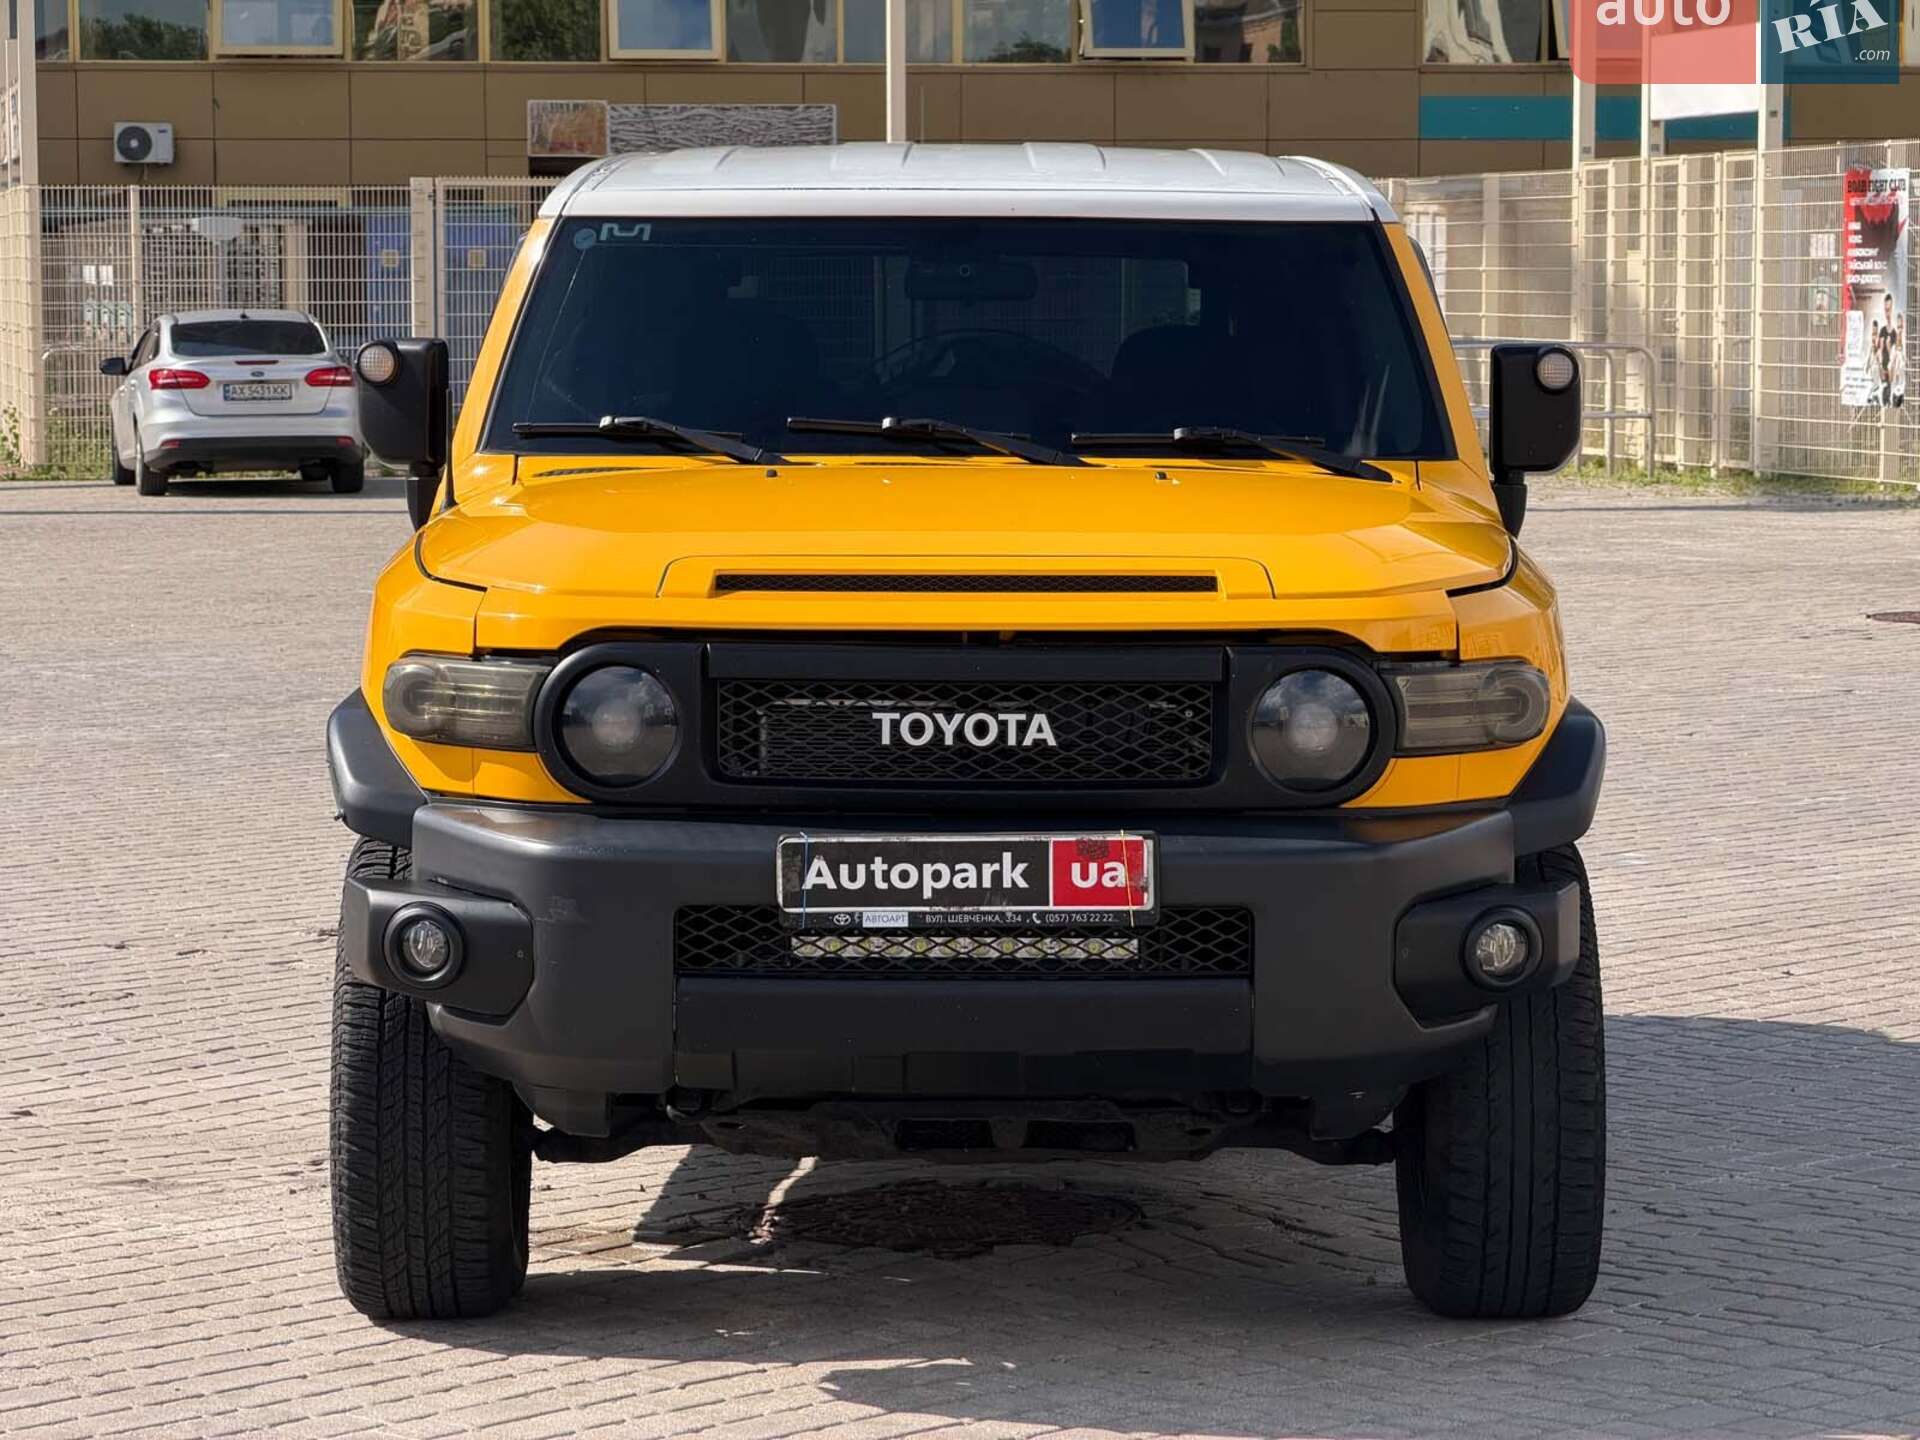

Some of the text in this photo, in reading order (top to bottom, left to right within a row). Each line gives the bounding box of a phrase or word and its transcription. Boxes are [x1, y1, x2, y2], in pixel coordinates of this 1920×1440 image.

[872, 712, 1057, 747] TOYOTA
[801, 851, 1126, 900] Autopark ua
[1045, 912, 1069, 923] (057)
[1089, 912, 1101, 923] 22
[1102, 912, 1114, 923] 22
